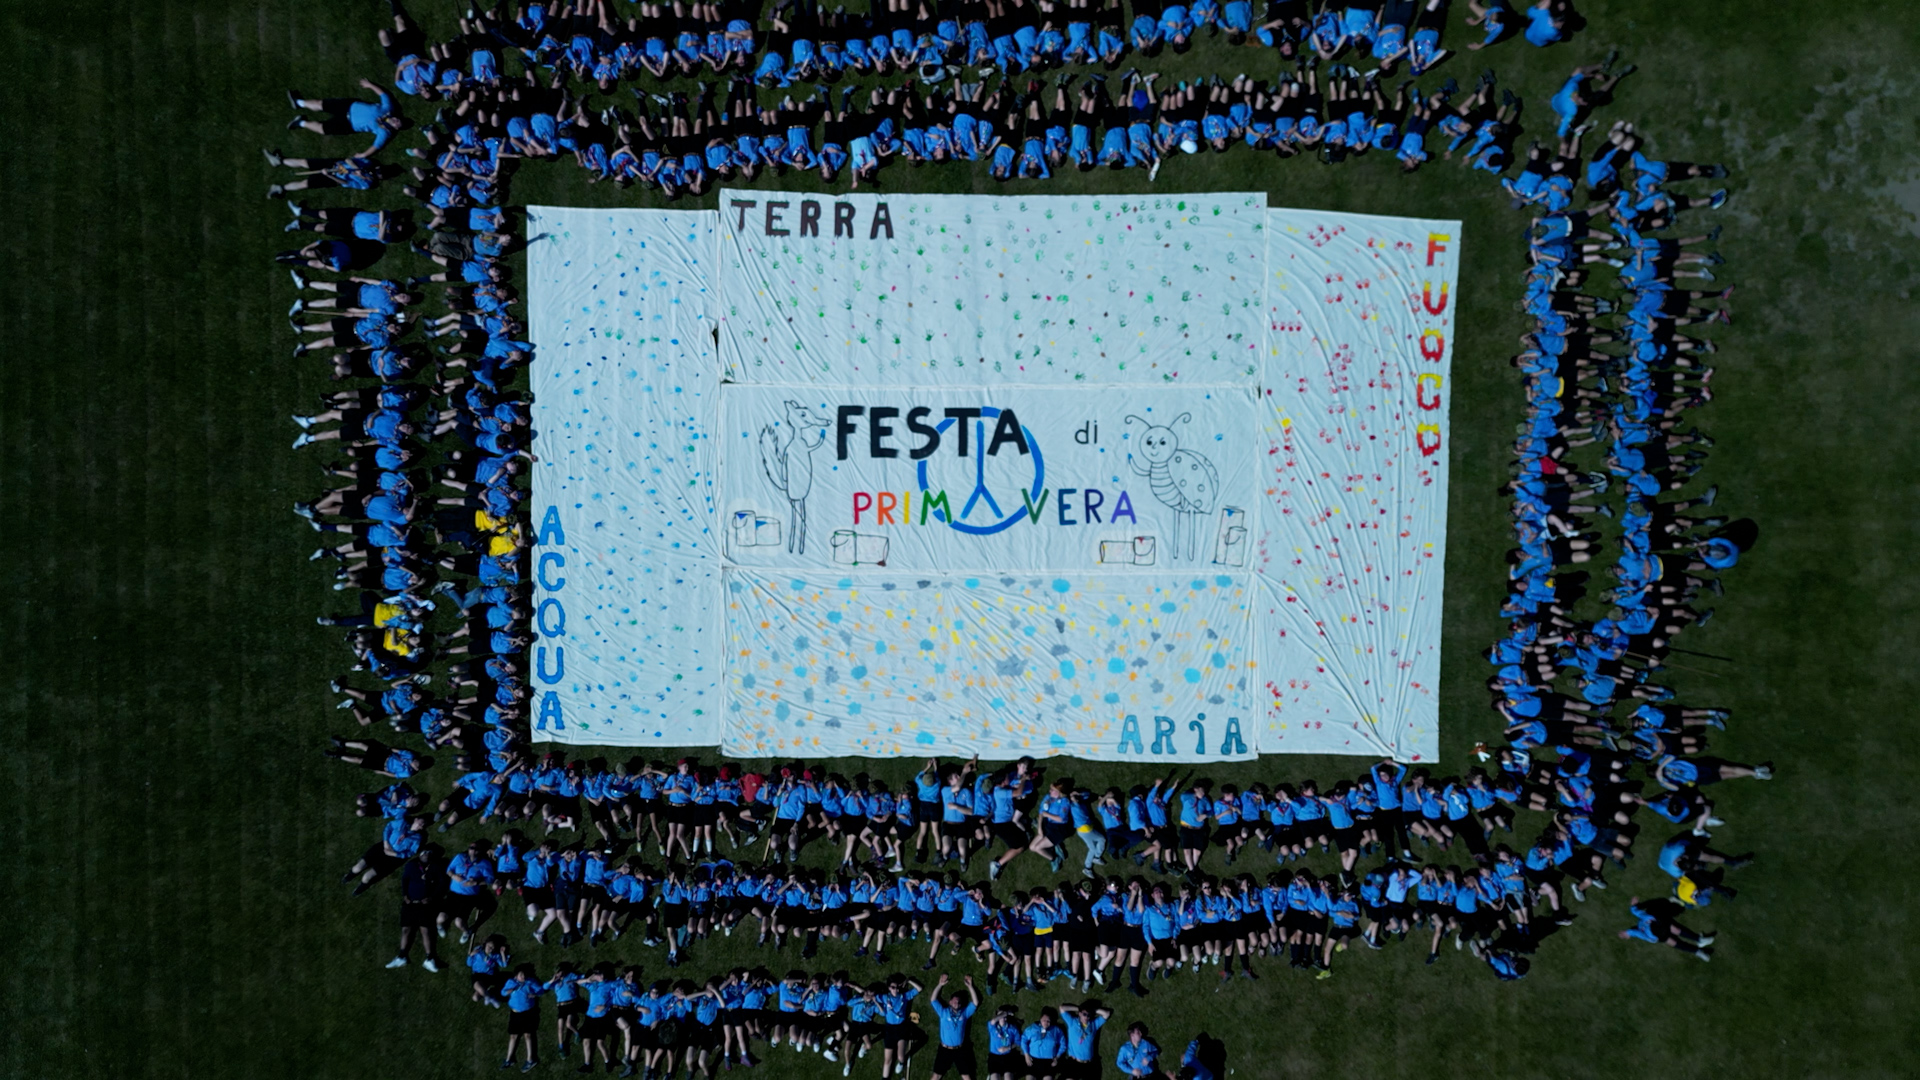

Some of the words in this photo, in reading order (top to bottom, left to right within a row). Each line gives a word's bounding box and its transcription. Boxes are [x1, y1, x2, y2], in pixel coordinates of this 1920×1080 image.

[731, 199, 894, 240] TERRA
[1416, 232, 1451, 457] FUOCO
[837, 405, 1029, 460] FESTA
[1074, 420, 1098, 444] di
[536, 506, 566, 730] ACQUA
